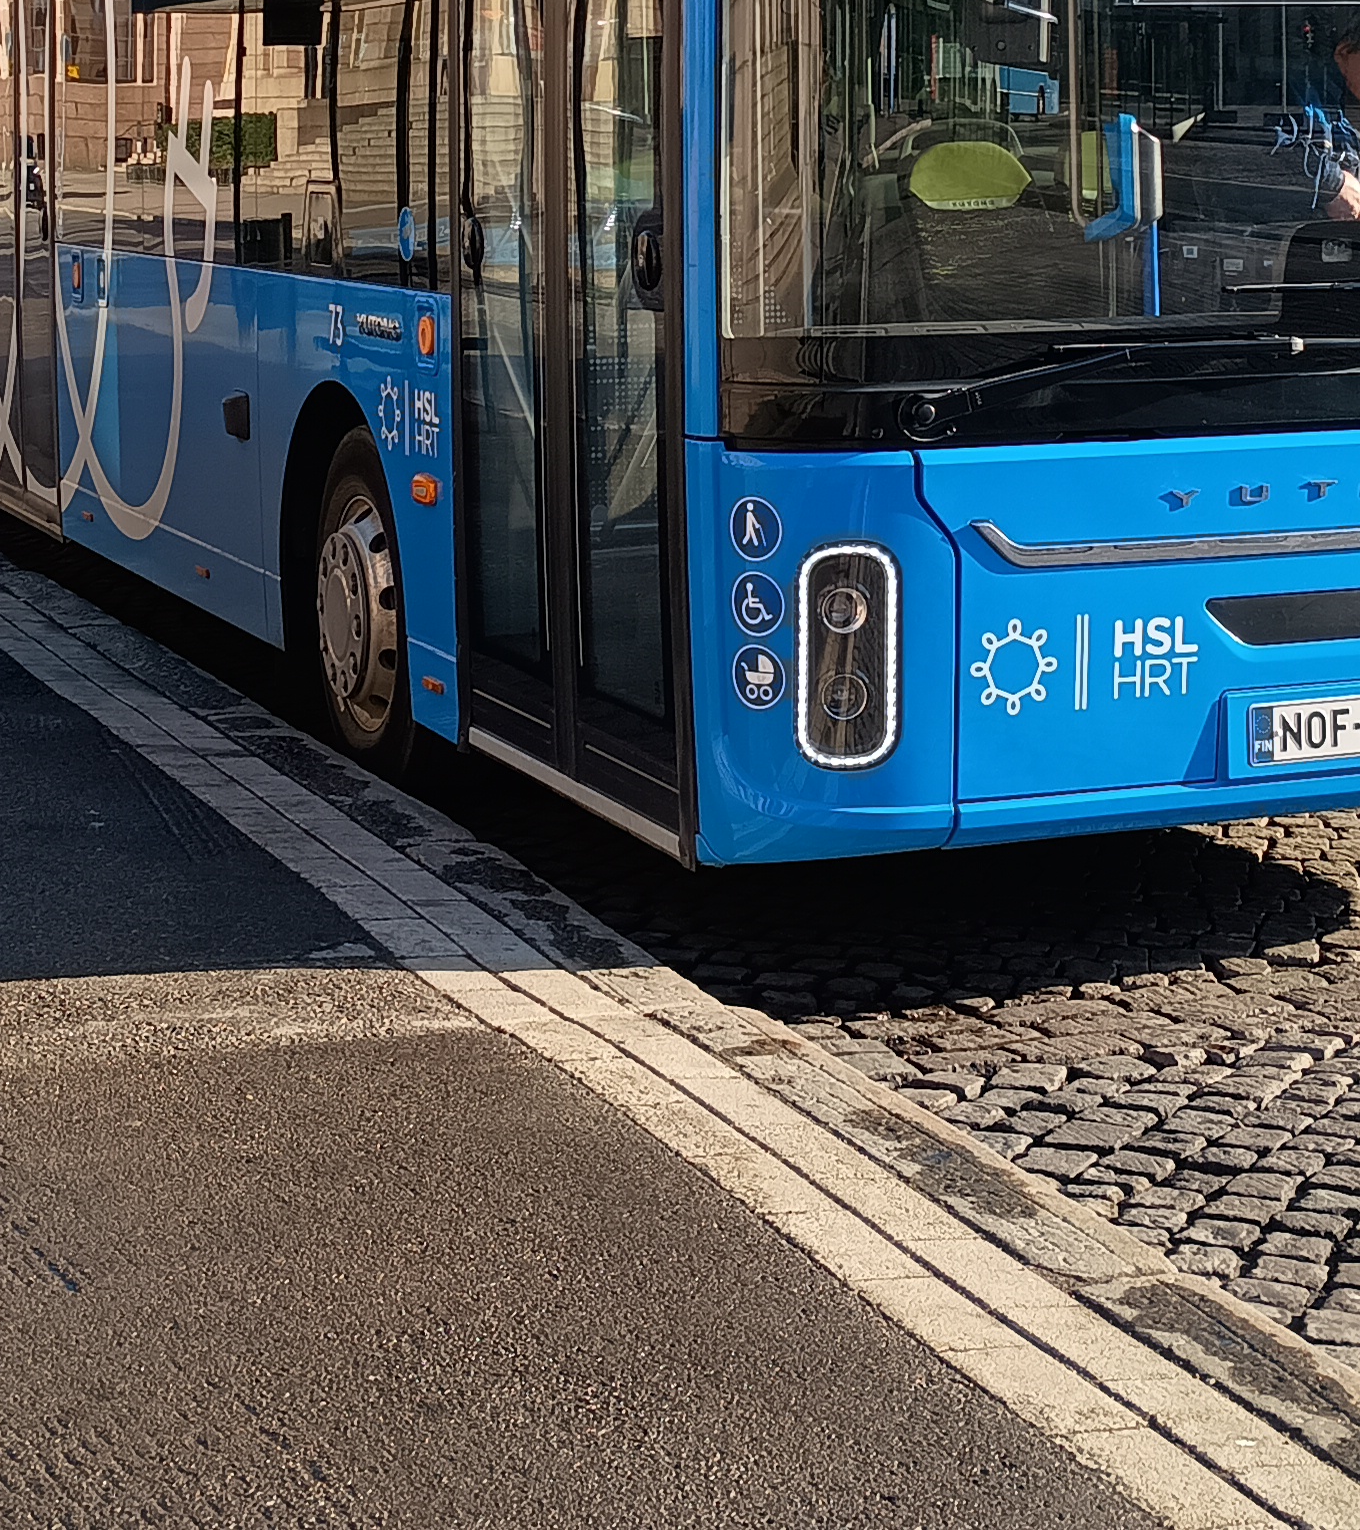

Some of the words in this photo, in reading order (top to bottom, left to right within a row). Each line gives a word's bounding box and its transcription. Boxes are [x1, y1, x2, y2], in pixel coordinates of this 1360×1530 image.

[329, 304, 343, 346] 73
[415, 389, 440, 425] HSL
[415, 422, 440, 458] HRT
[1114, 616, 1199, 658] HSL
[1113, 657, 1199, 700] HRT
[1254, 739, 1273, 753] FIN
